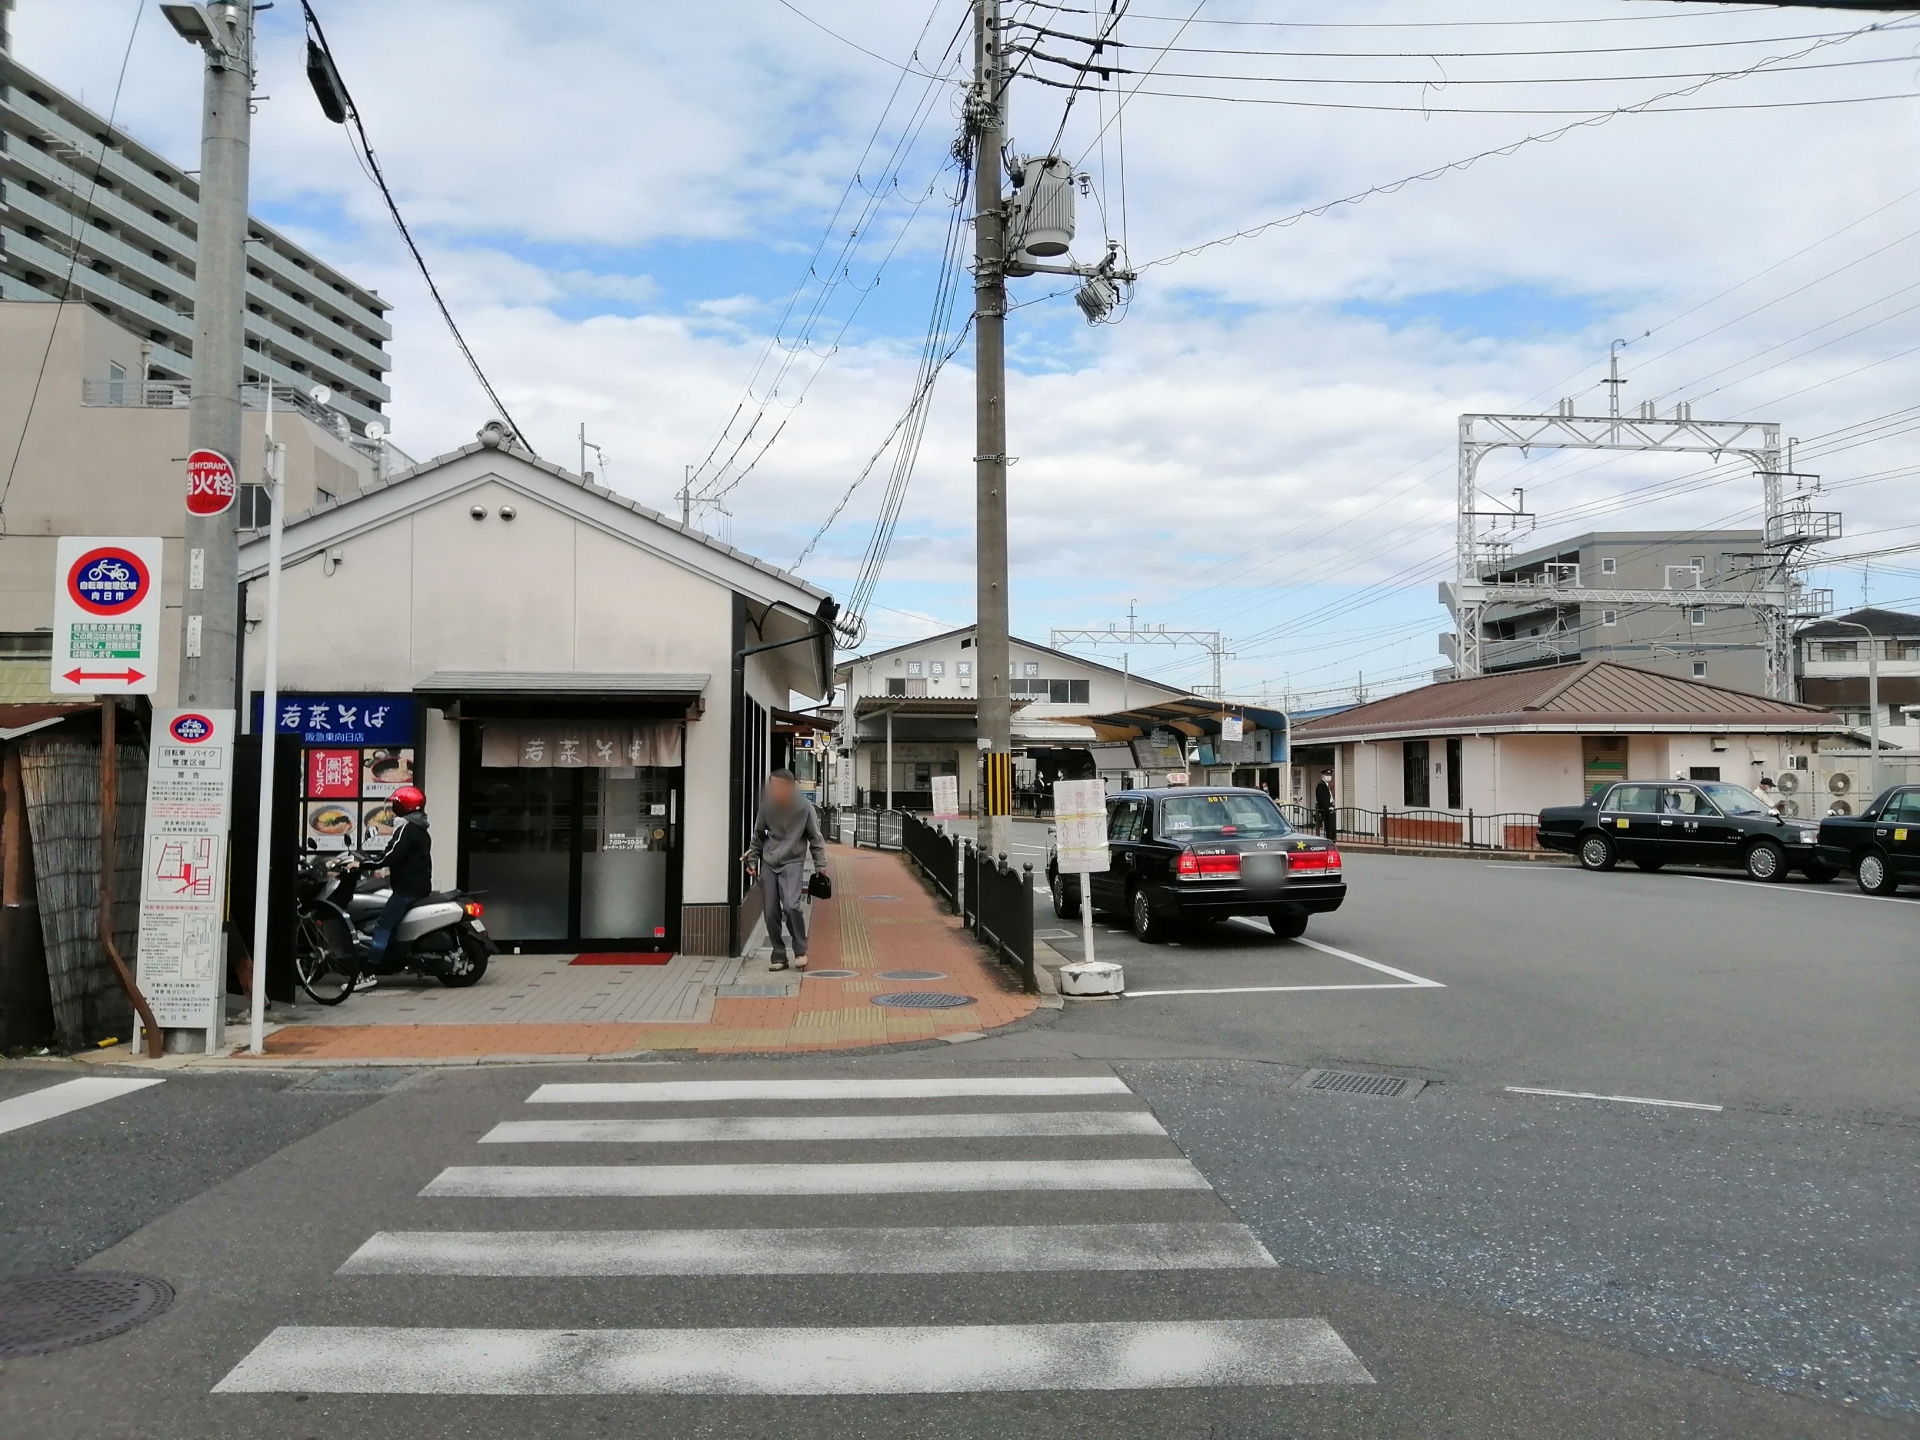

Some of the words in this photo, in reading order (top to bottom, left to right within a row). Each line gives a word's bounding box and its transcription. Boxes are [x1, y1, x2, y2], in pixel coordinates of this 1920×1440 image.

[195, 461, 227, 471] HYDRANT
[91, 591, 125, 601] 向日市
[280, 701, 390, 730] 若菜そば
[305, 732, 365, 742] 阪急東向日店
[525, 736, 644, 764] 若菜そば
[342, 755, 354, 787] 天かす
